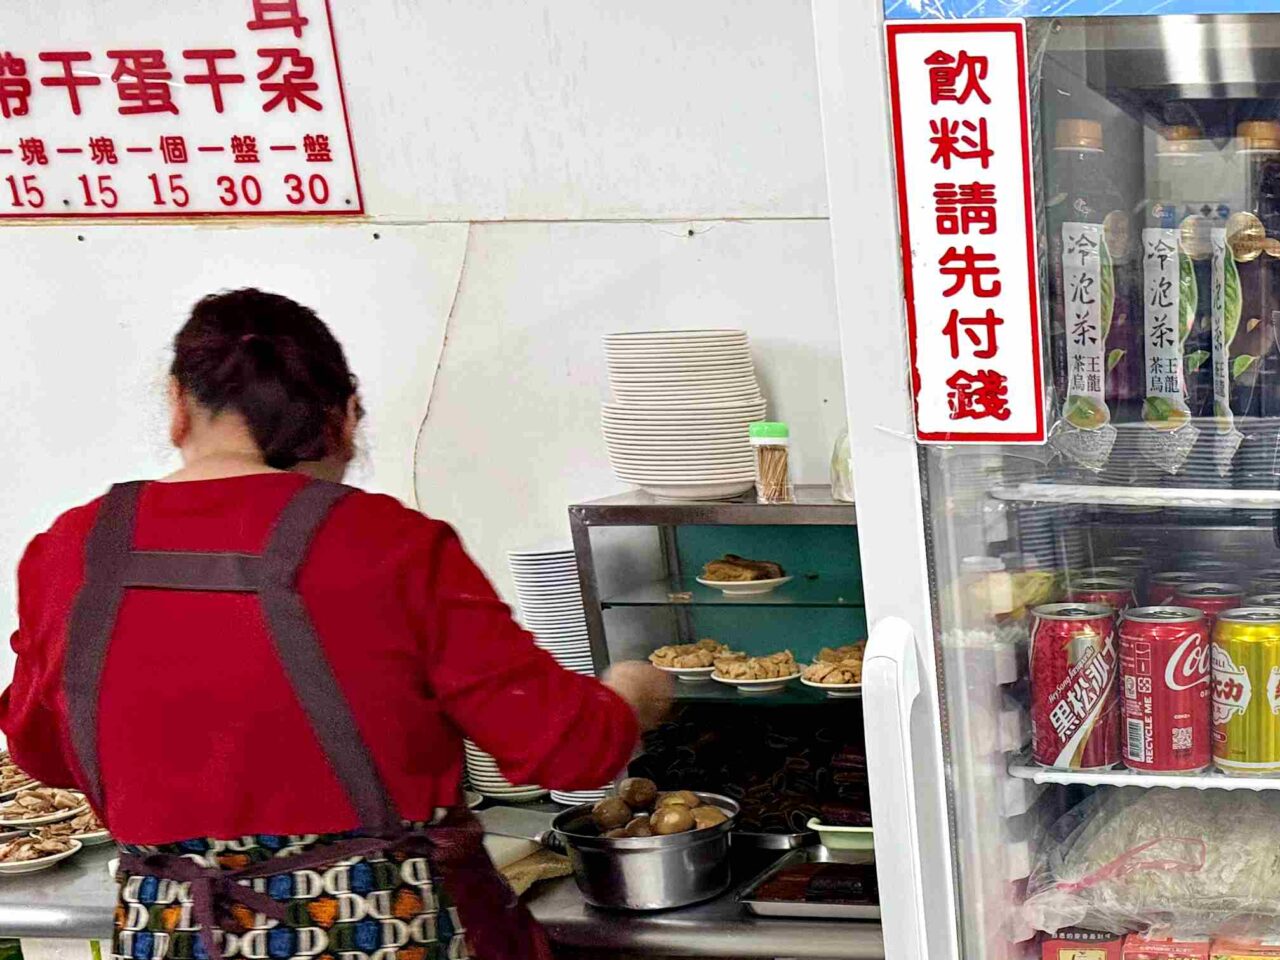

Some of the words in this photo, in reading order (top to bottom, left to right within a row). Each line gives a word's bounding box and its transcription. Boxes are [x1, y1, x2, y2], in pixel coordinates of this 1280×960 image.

[6, 175, 45, 208] 15
[78, 174, 118, 208] 15
[148, 173, 190, 207] 15
[216, 175, 262, 206] 30
[284, 174, 330, 205] 30
[924, 50, 1011, 421] 飲料請先付錢
[1068, 233, 1098, 347] 冷泡茶
[1147, 238, 1176, 348] 冷泡茶
[1049, 630, 1118, 743] 黑松沙士
